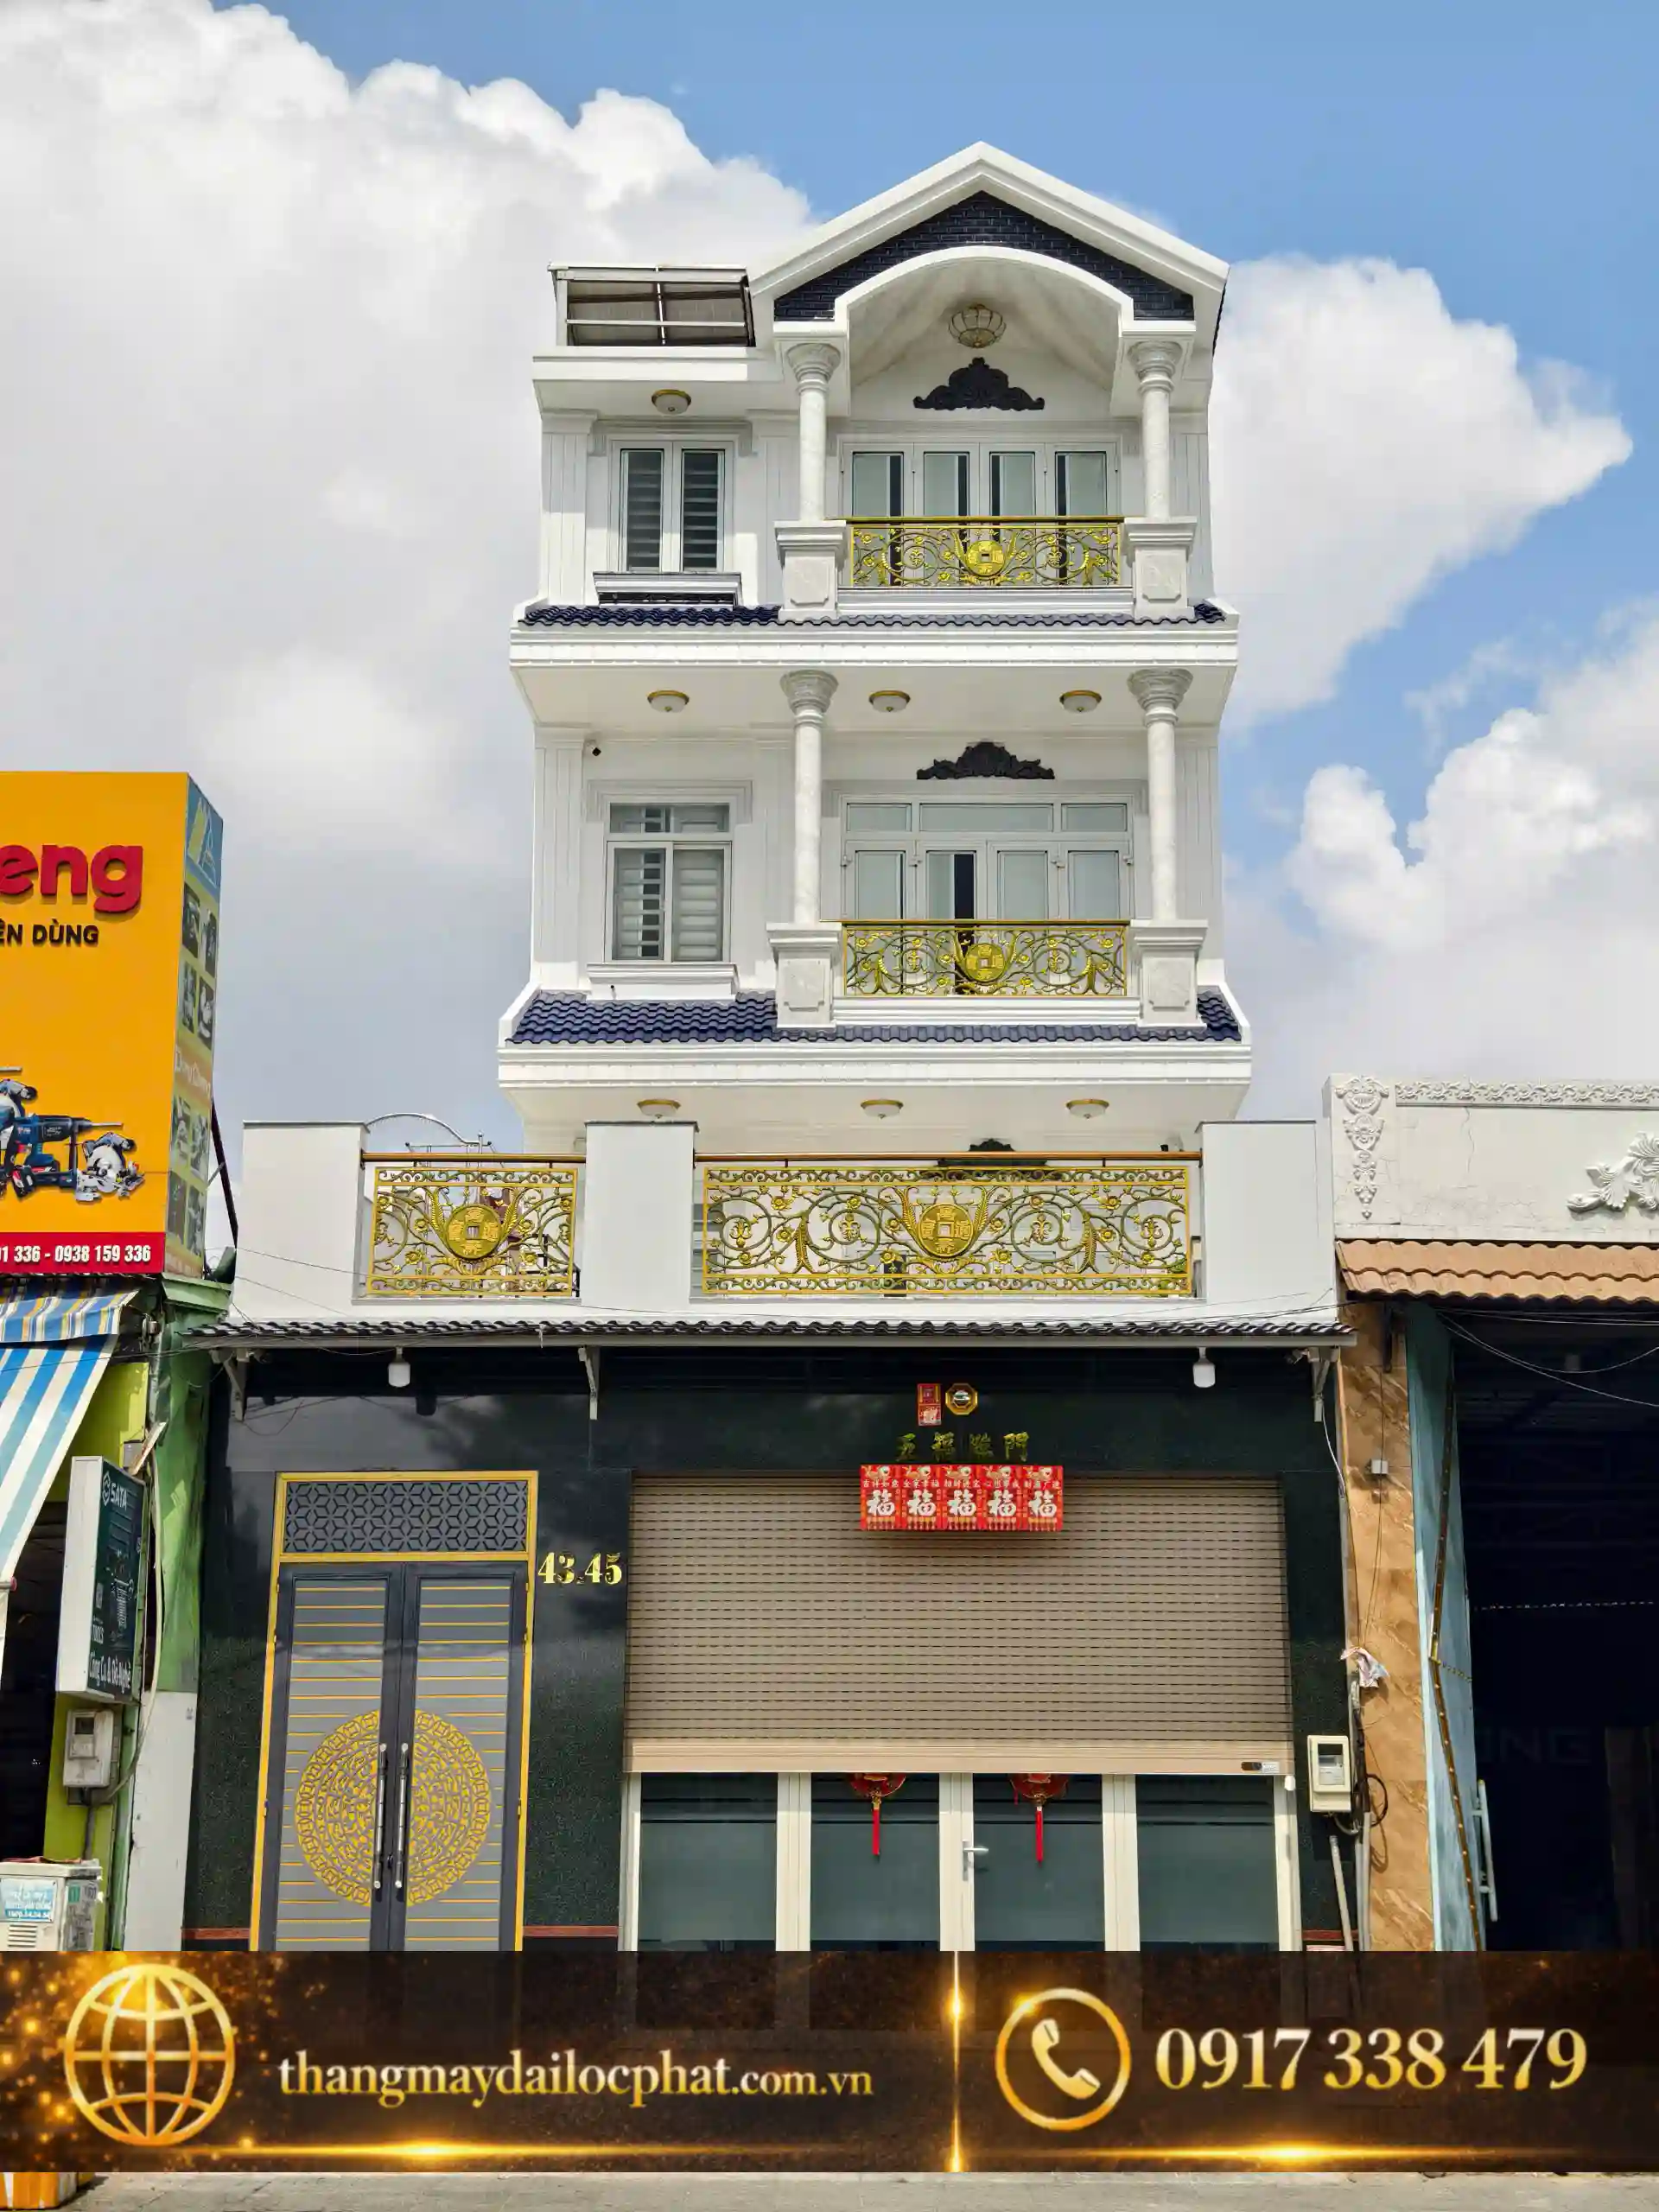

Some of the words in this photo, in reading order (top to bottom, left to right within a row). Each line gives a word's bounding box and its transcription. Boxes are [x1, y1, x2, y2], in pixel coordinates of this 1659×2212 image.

[33, 917, 99, 947] DÙNG
[0, 1245, 9, 1263] 1
[14, 1245, 41, 1263] 336
[54, 1245, 90, 1263] 0938
[94, 1244, 121, 1263] 159
[124, 1244, 151, 1263] 336
[111, 1482, 127, 1511] SATA
